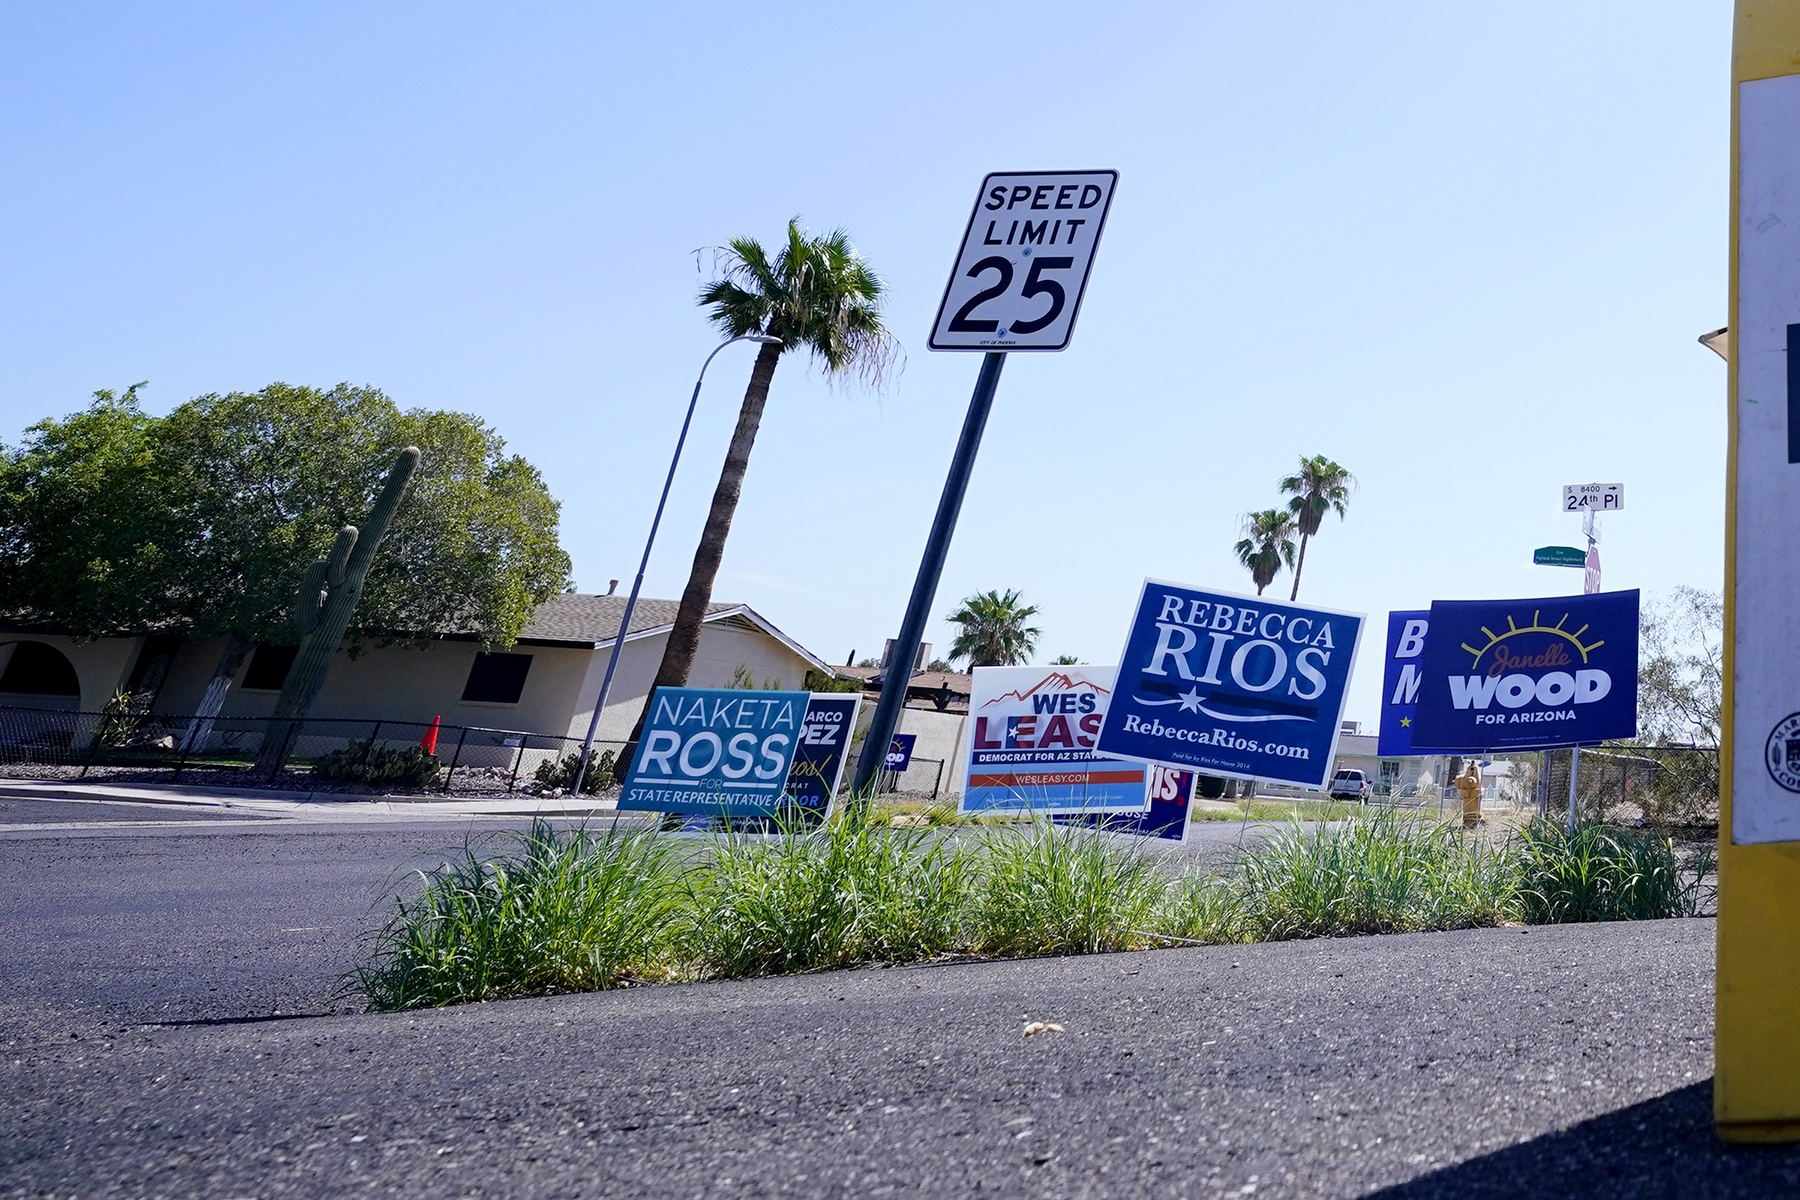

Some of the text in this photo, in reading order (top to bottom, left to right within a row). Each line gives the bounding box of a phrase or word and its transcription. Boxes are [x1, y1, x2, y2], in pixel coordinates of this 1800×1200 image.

[985, 185, 1102, 210] SPEED
[983, 220, 1086, 245] LIMIT
[948, 256, 1075, 334] 25
[1580, 485, 1601, 493] 8400
[1567, 494, 1618, 510] 24th Pl
[1156, 594, 1335, 649] REBECCA
[1141, 622, 1331, 700] RIOS
[1488, 642, 1572, 678] Janelle
[1448, 669, 1612, 709] WOOD
[653, 696, 794, 730] NAKETA
[1033, 693, 1096, 714] WES
[805, 711, 843, 722] ARCO
[1475, 709, 1577, 725] FOR ARIZONA
[973, 714, 1104, 749] LEAS
[1123, 714, 1310, 760] RebeccaRios.com
[637, 730, 790, 780] ROSS
[978, 753, 1032, 762] DEMOCRAT
[1034, 752, 1054, 761] FOR
[1056, 751, 1070, 760] AZ
[699, 778, 723, 789] FOR
[1016, 774, 1090, 784] WESLEASY.COM
[628, 788, 773, 807] STATE REPRESENTATIVE
